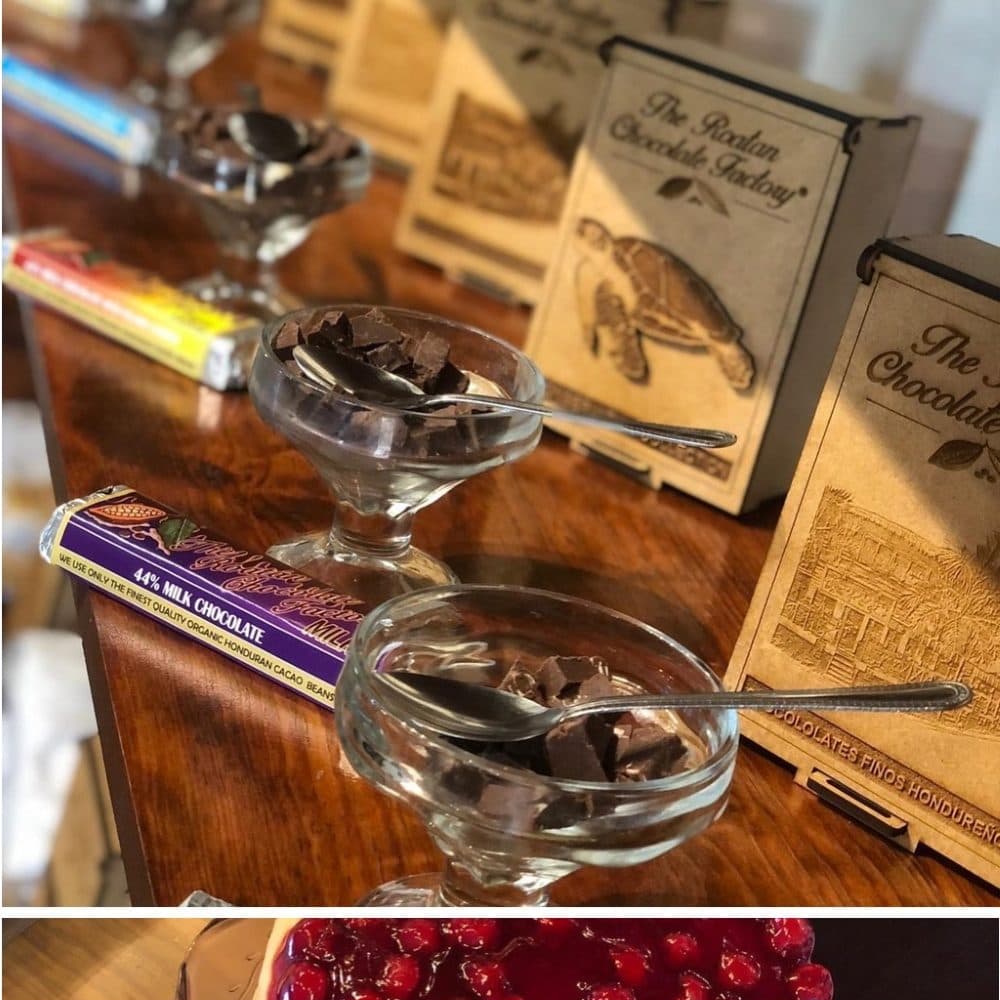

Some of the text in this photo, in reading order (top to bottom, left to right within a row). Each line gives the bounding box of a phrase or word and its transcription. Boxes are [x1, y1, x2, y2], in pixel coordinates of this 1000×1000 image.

[690, 111, 780, 163] Roatan
[911, 324, 980, 375] The
[866, 350, 1000, 434] Chocolate
[59, 553, 335, 701] WE USE ONLY THE FINEST QUALITY ORGANIC HONDURAN CACAO BEANS
[133, 567, 266, 645] 44% MILK CHOCOLATE
[860, 753, 906, 789] FINOS
